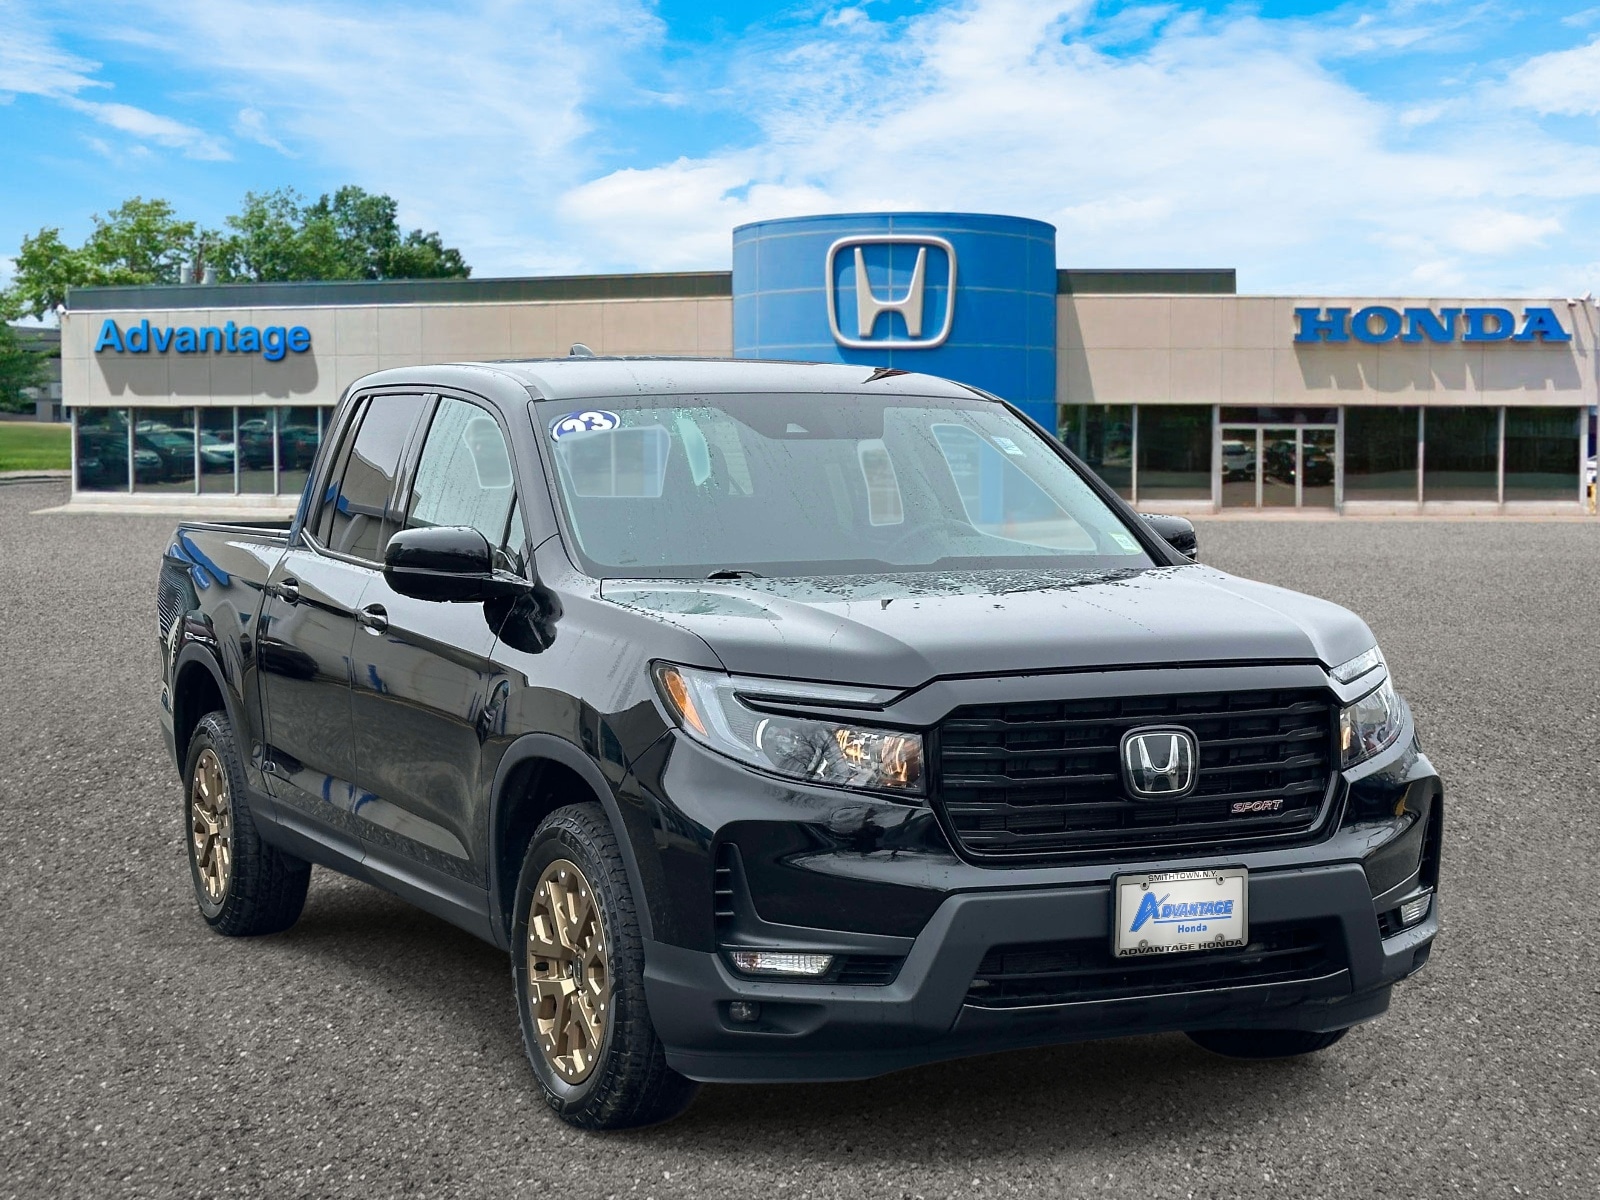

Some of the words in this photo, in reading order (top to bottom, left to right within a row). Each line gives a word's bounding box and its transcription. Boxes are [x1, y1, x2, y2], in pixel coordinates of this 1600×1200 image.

[1294, 306, 1572, 343] HONDA
[95, 319, 311, 362] Advantage
[1231, 799, 1283, 813] SPORT
[1129, 892, 1234, 932] ADVANTAGE
[1177, 923, 1208, 933] Honda
[1120, 943, 1195, 956] ADVANTAGE
[1198, 939, 1243, 950] HONDA
